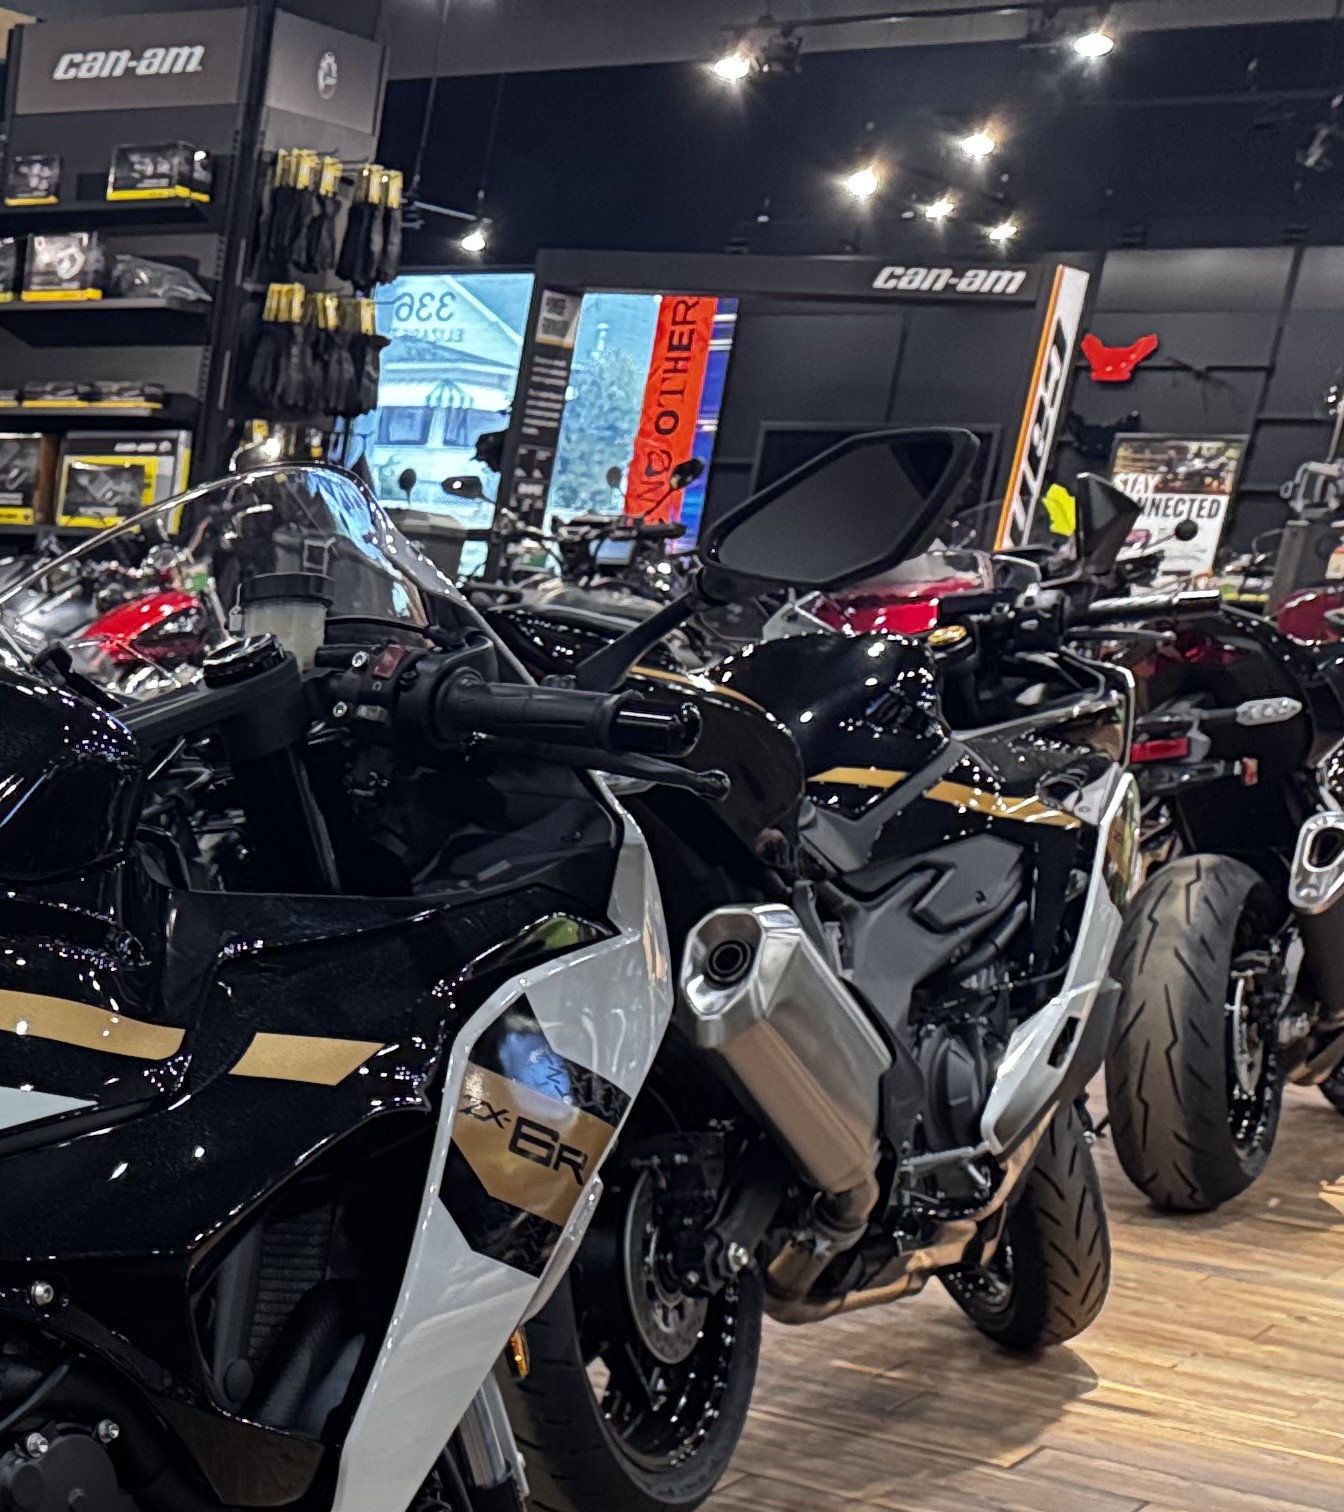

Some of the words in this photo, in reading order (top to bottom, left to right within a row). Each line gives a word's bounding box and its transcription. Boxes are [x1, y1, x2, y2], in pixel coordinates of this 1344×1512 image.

[53, 44, 205, 81] can-am
[872, 265, 1028, 295] can-am
[653, 297, 702, 438] OTHER
[1112, 472, 1162, 496] STAY
[1137, 495, 1222, 520] NNECTED
